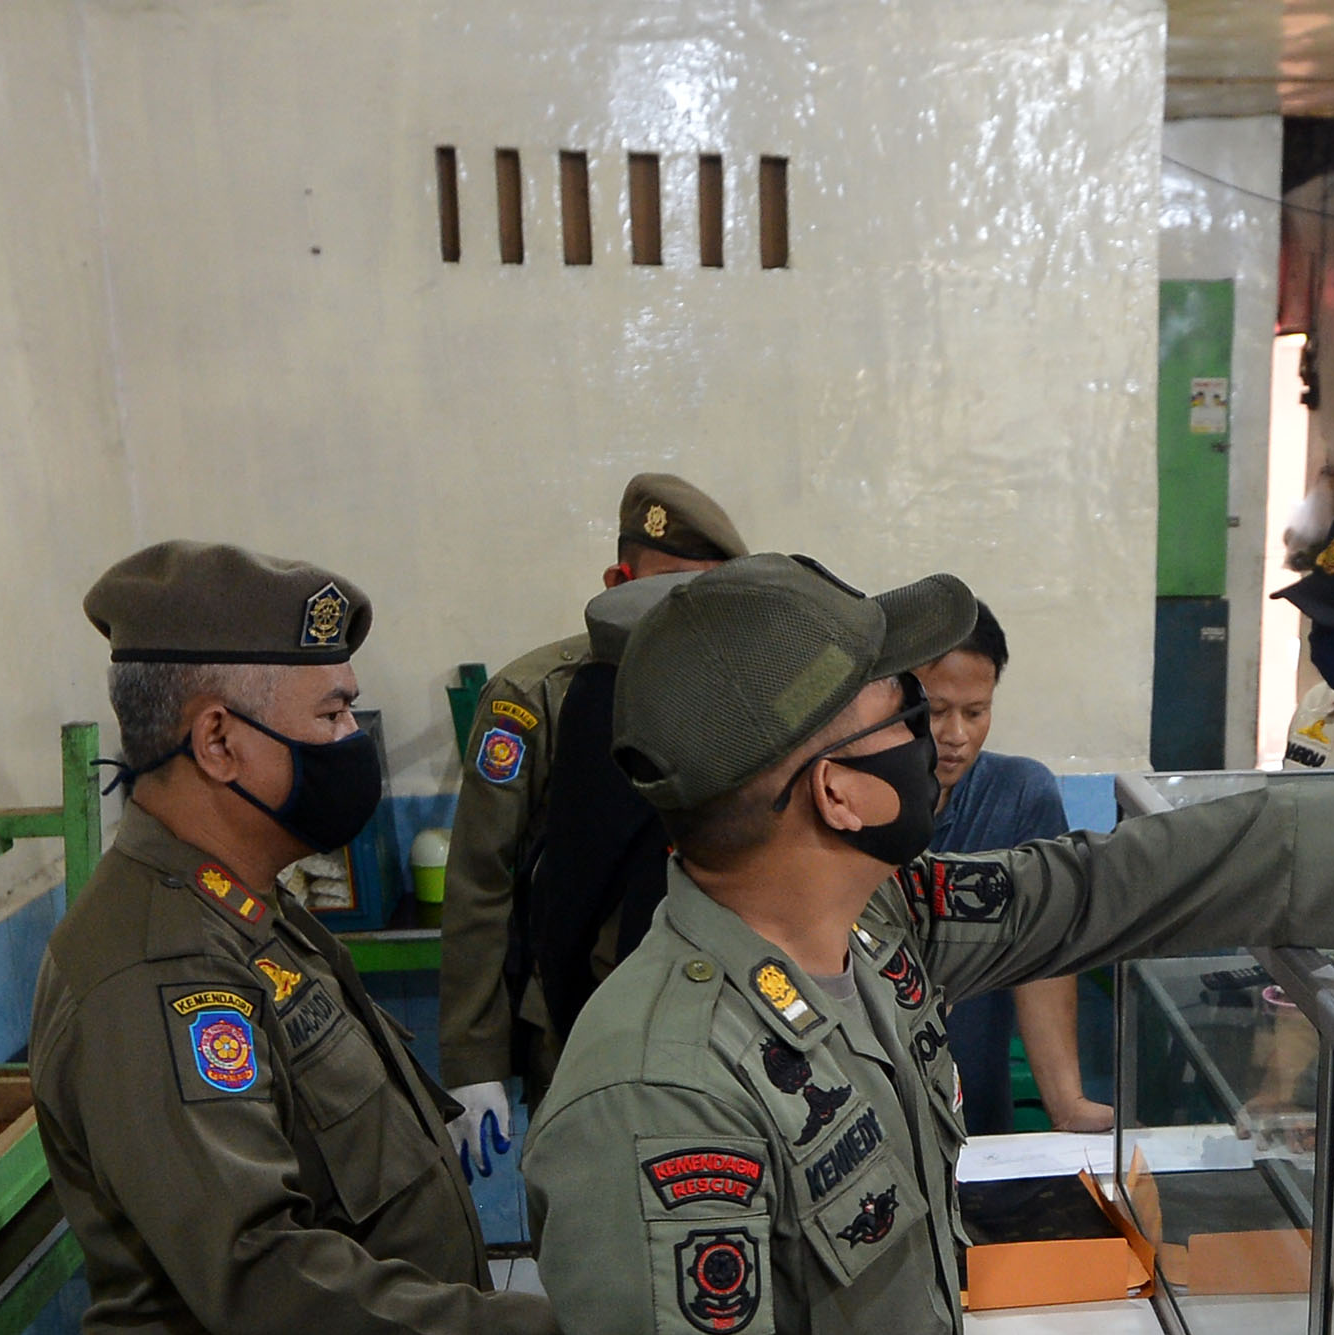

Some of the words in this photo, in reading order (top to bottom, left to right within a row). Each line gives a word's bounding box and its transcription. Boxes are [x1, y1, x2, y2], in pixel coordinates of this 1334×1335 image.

[177, 991, 251, 1015] KEMENDAGRI
[652, 1153, 760, 1180] KEMENDAGRI
[805, 1106, 884, 1202] KENNEDY
[671, 1177, 748, 1199] RESCUE
